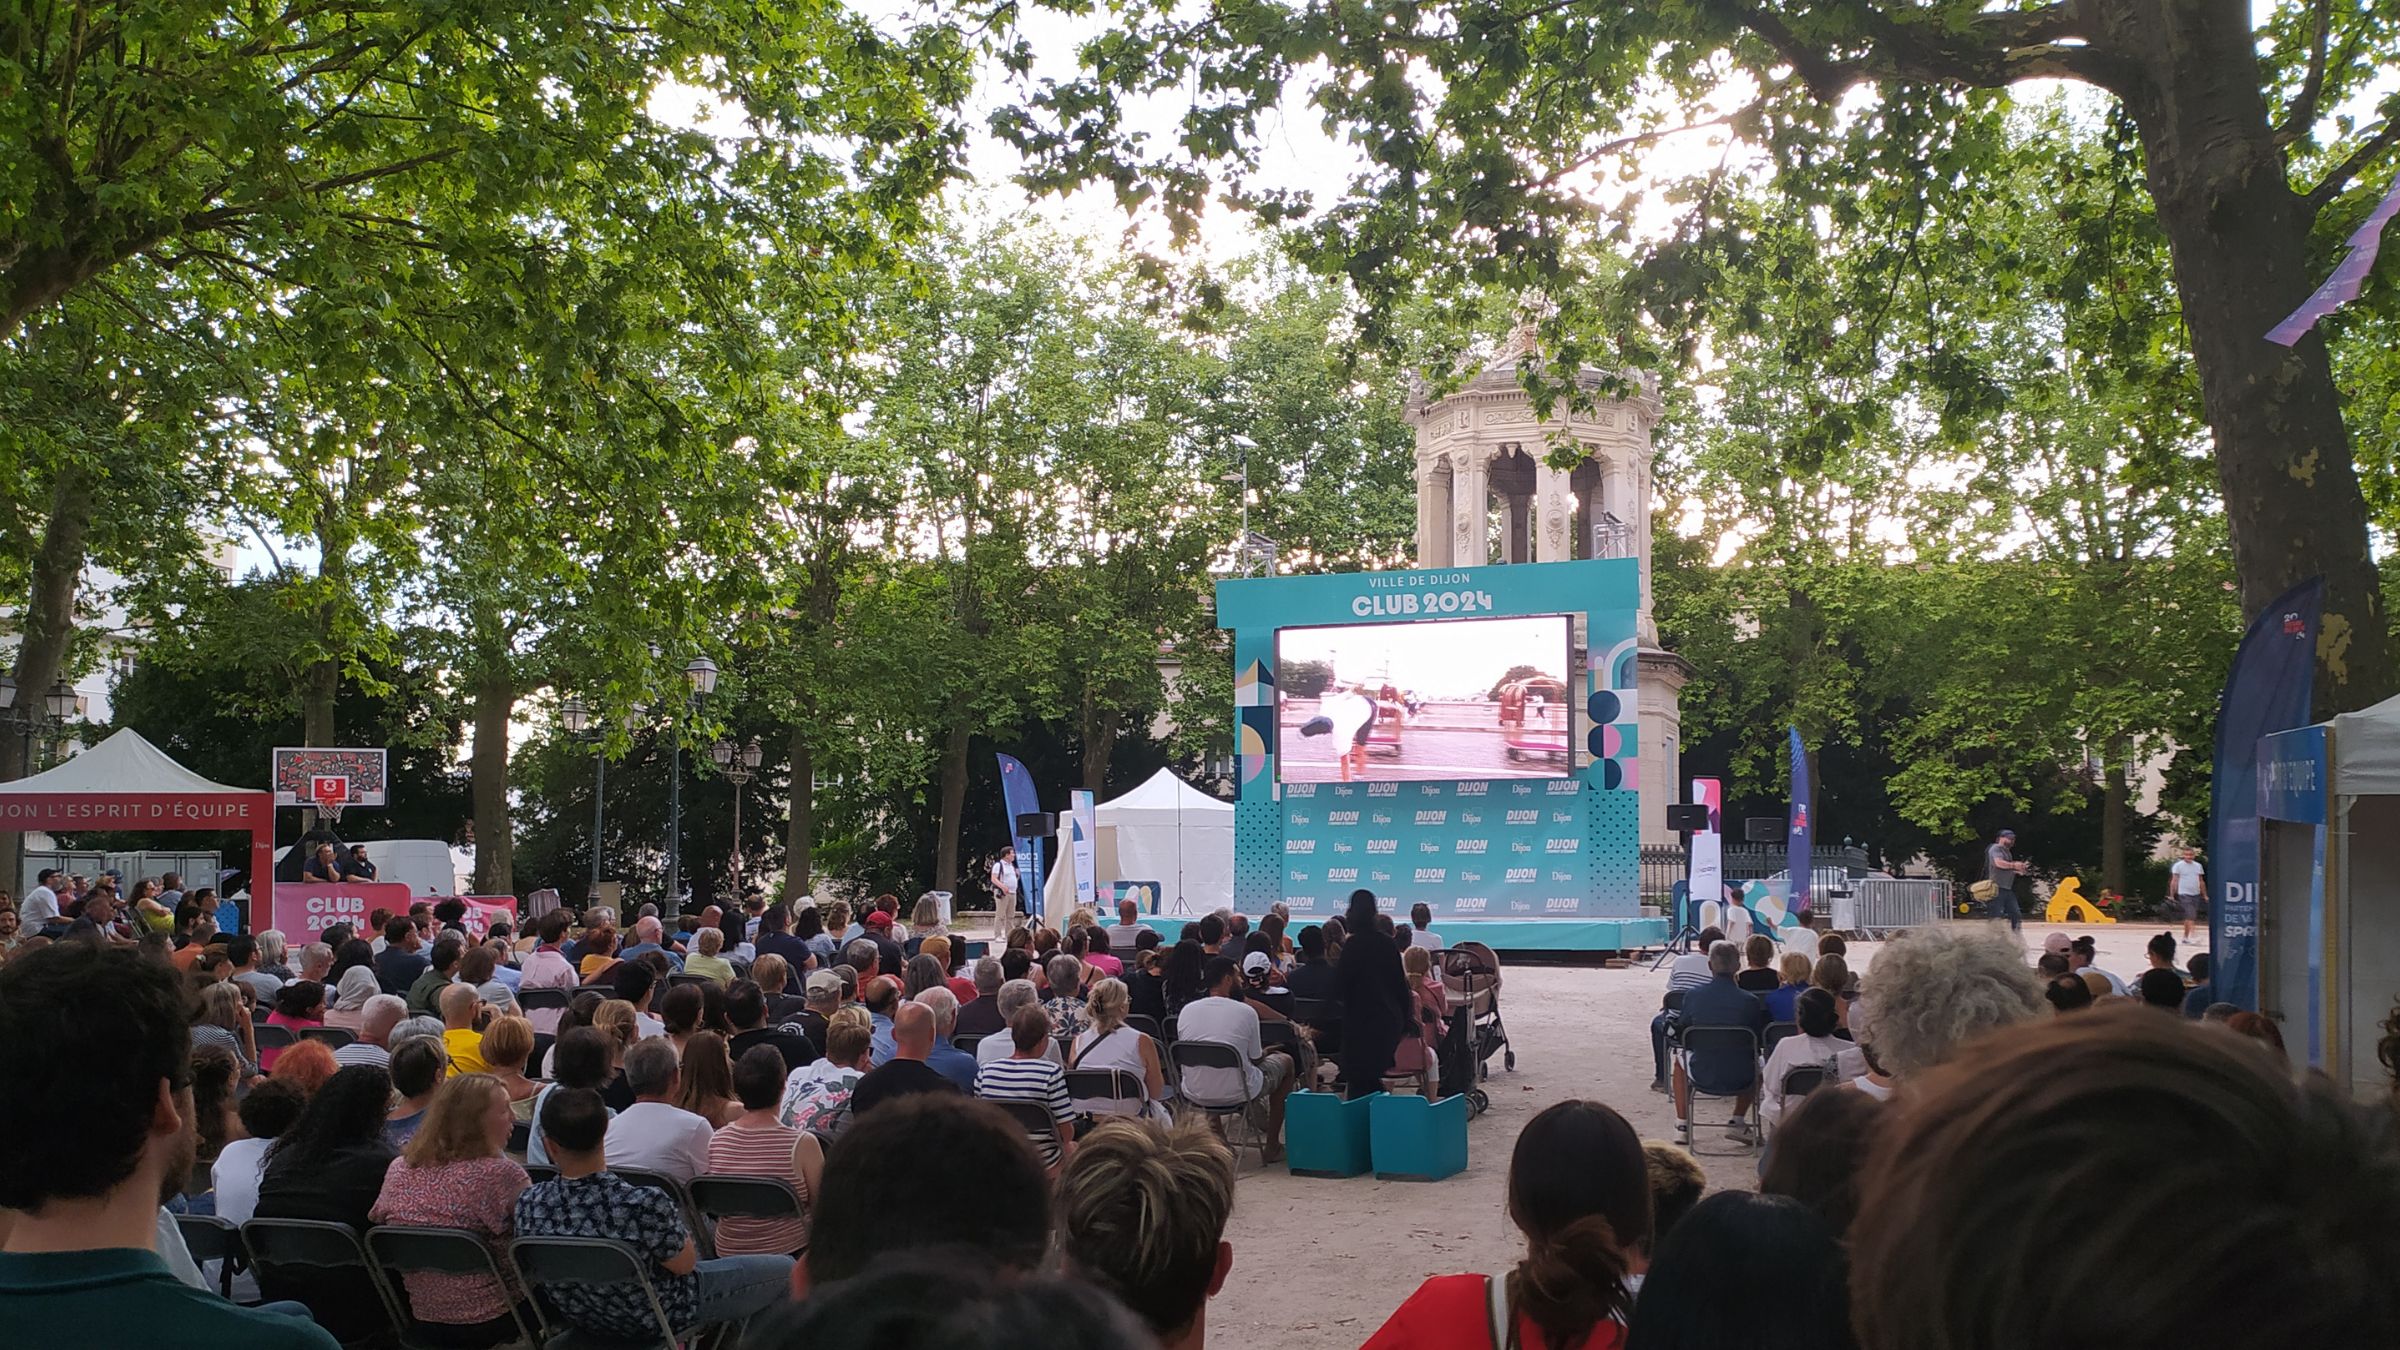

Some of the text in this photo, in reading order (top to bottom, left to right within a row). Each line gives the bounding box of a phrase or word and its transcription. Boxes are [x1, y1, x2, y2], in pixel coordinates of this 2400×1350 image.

[1369, 573, 1470, 588] VILLE DE DIJON
[1352, 591, 1492, 616] CLUB 2024
[1287, 783, 1317, 794] DIJON
[1368, 783, 1399, 793] DIJON
[1457, 782, 1489, 792] DIJON
[1547, 780, 1580, 791] DIJON
[48, 804, 142, 817] L'ESPRIT
[151, 802, 249, 820] D'ÉQUIPE
[1328, 811, 1360, 821] DIJON
[1415, 810, 1447, 821] DIJON
[1506, 810, 1539, 820] DIJON
[1286, 839, 1316, 850] DIJON
[1366, 839, 1398, 850] DIJON
[1456, 839, 1488, 850] DIJON
[1546, 839, 1579, 849] DIJON
[1327, 868, 1359, 878] DIJON
[1414, 868, 1446, 878] DIJON
[1506, 868, 1537, 878] DIJON
[306, 897, 365, 912] CLUB
[1286, 897, 1315, 907] DIJON
[1456, 898, 1487, 908] DIJON
[1546, 898, 1579, 908] DIJON
